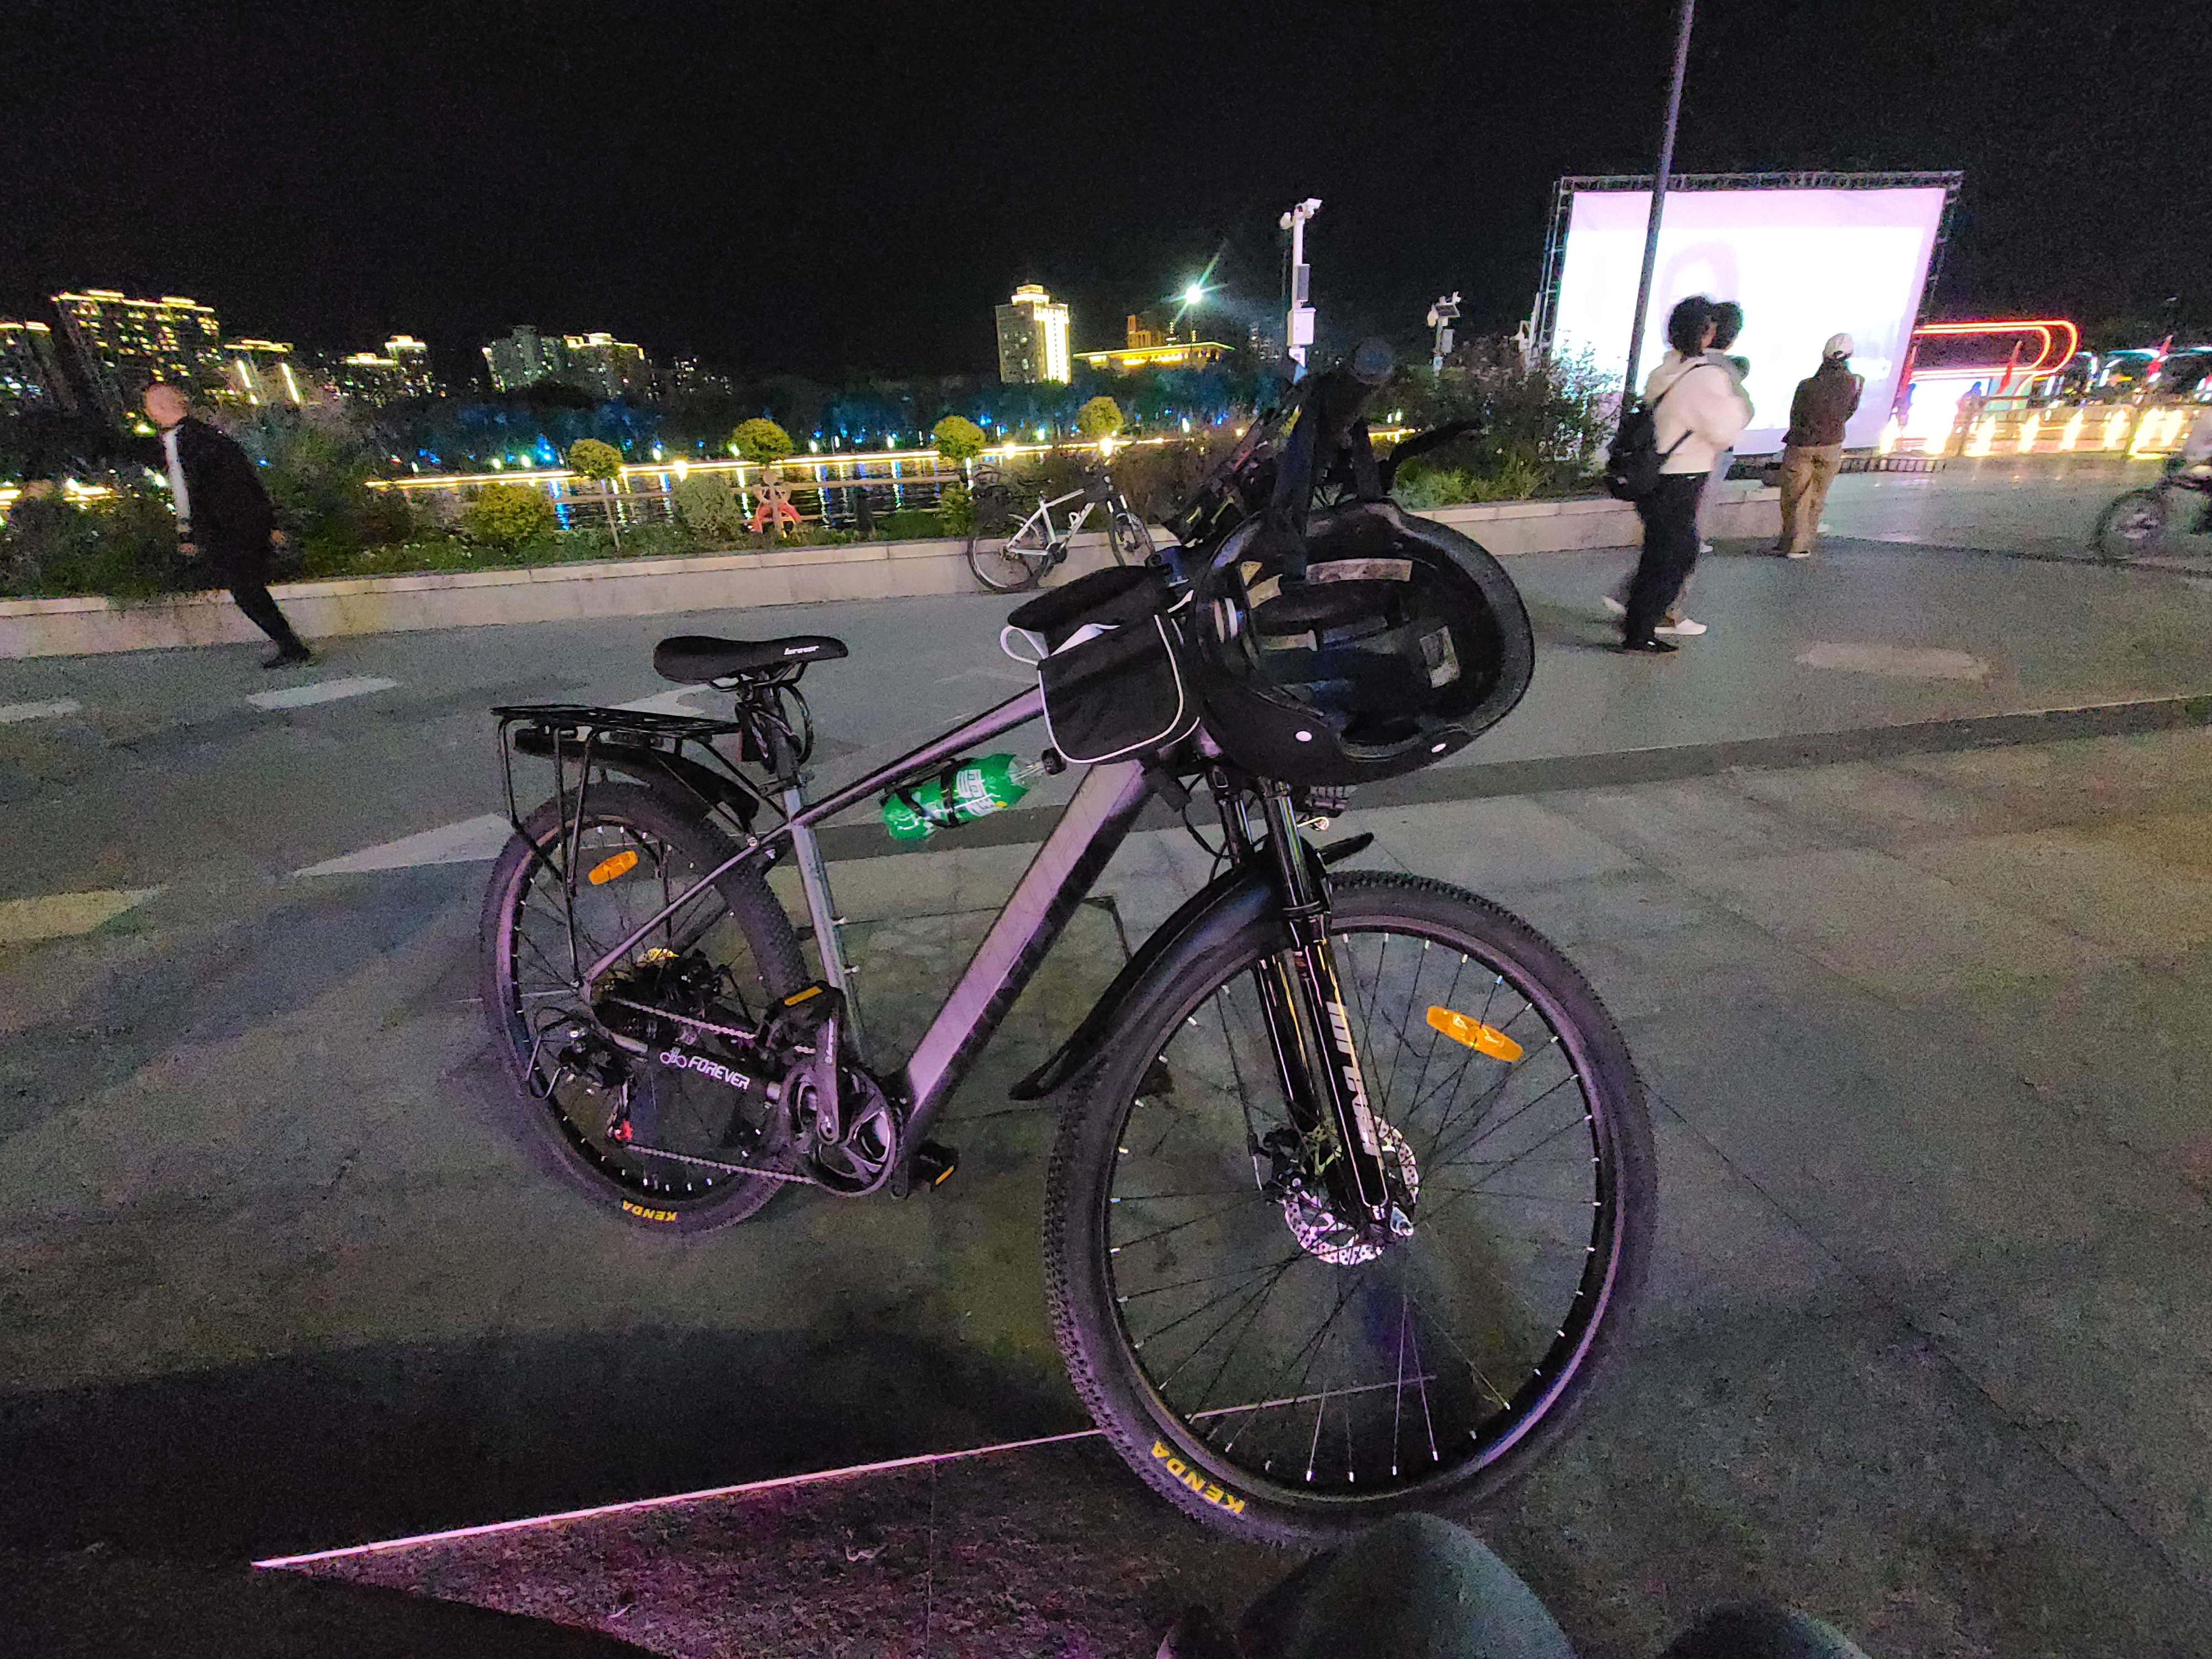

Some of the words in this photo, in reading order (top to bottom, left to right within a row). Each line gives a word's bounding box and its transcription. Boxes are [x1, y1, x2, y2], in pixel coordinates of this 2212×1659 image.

[688, 1055, 750, 1091] FOREVER
[620, 1199, 677, 1222] KENDA
[1151, 1439, 1245, 1514] KENDA
